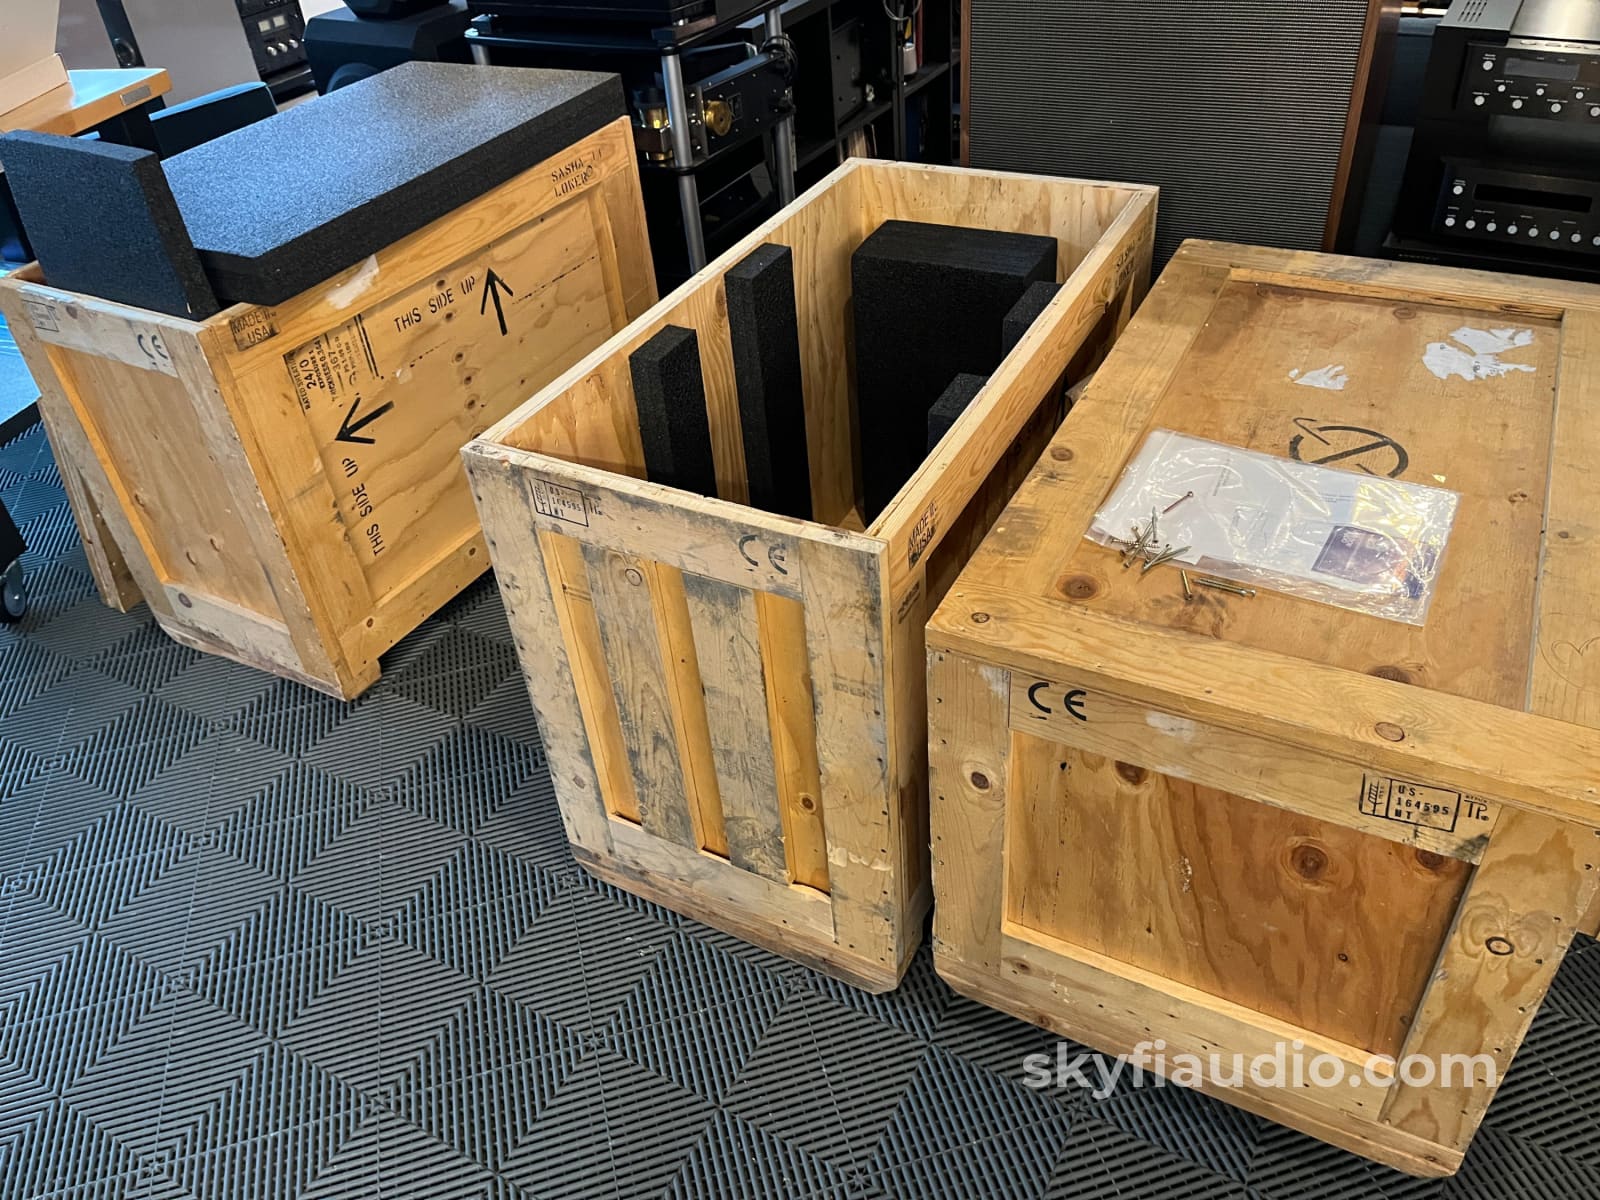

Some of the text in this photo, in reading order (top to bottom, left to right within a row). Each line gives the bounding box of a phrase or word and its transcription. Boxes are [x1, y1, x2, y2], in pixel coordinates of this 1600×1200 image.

[551, 158, 584, 182] SASHA
[394, 276, 475, 333] THIS SIDE UP
[231, 311, 262, 334] MADE
[247, 325, 269, 344] USA
[299, 359, 318, 390] 24/0
[328, 351, 341, 372] 367
[341, 457, 385, 556] THIS SIDE UP
[908, 511, 929, 550] MADE
[916, 528, 932, 555] USA
[1028, 682, 1087, 721] CE
